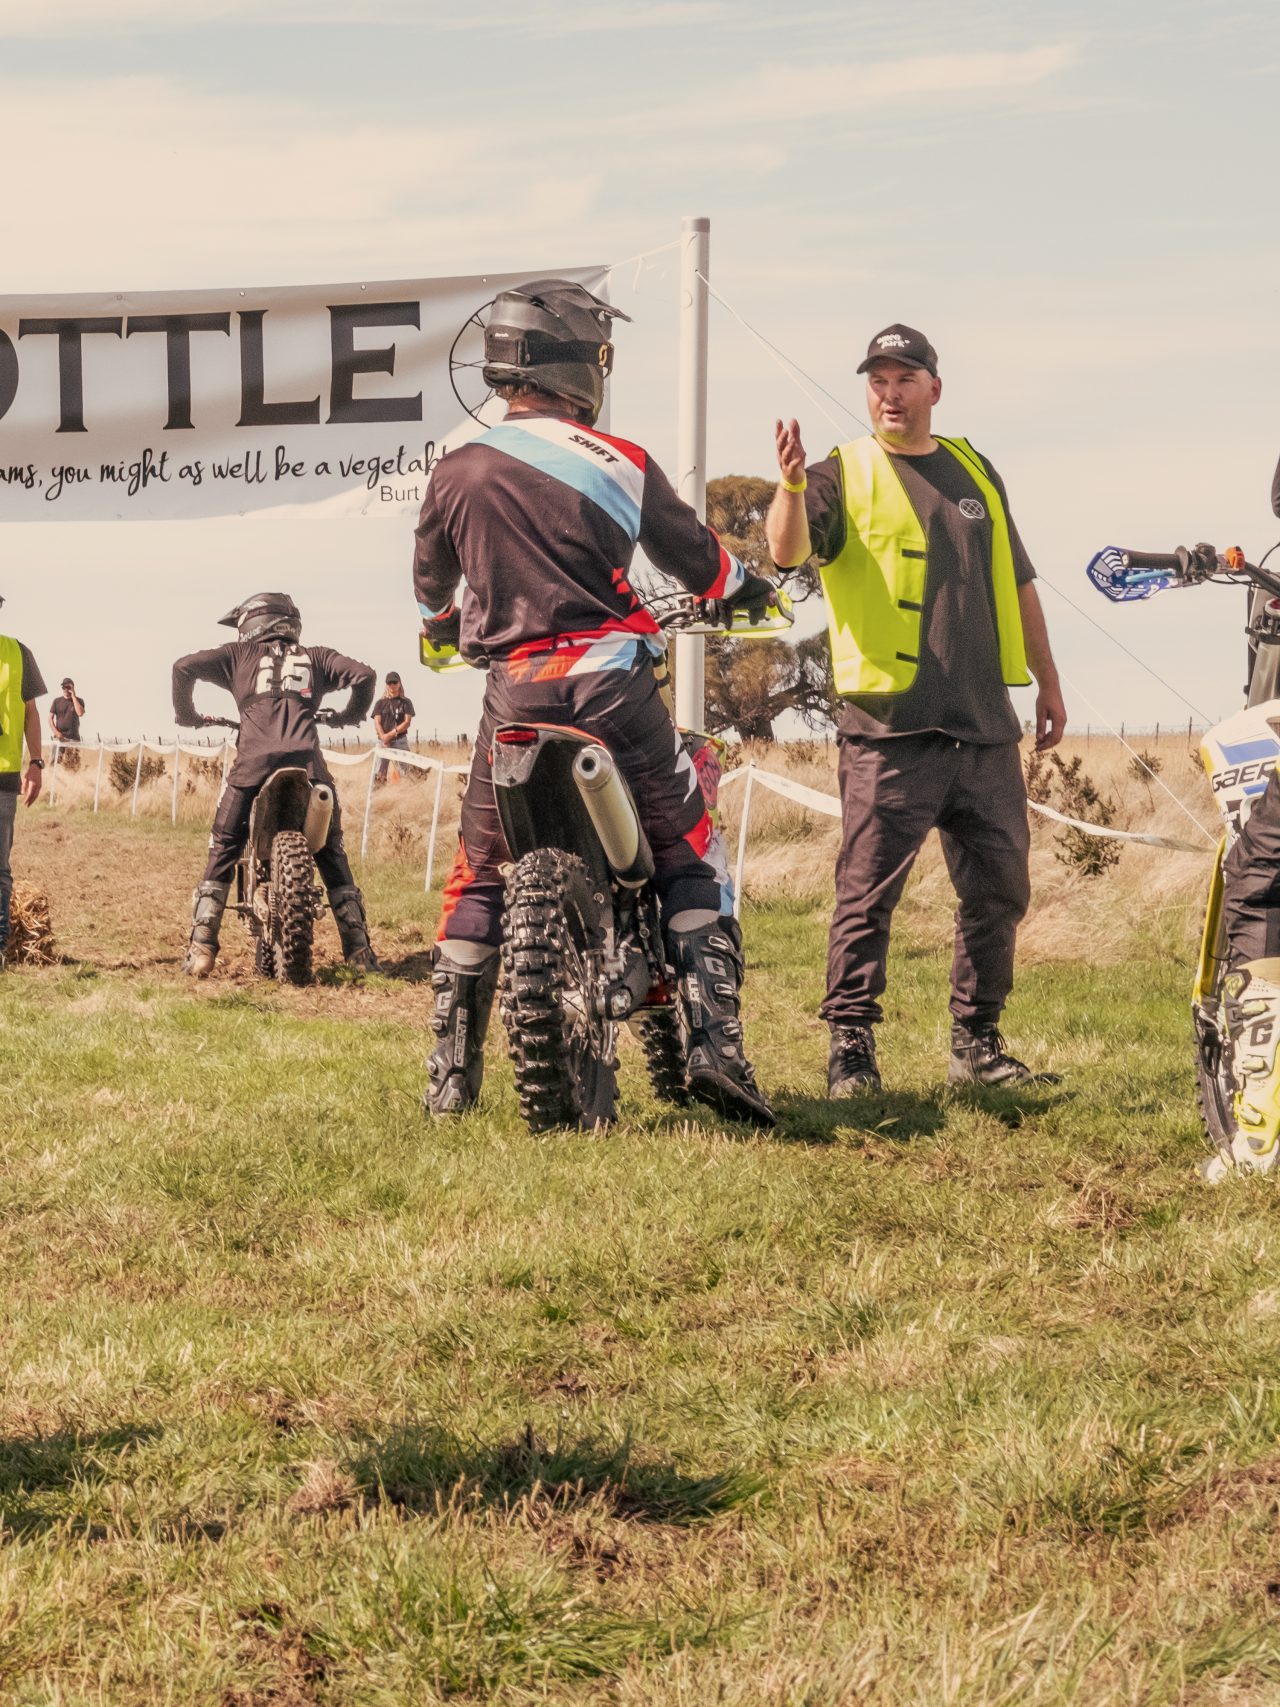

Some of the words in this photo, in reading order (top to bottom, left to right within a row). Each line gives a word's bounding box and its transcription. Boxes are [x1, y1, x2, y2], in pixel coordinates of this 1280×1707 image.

[567, 434, 620, 464] SHIFT
[44, 464, 93, 502] you
[100, 447, 172, 497] might
[178, 460, 205, 486] as
[212, 450, 268, 484] well
[274, 444, 308, 481] be
[314, 461, 333, 476] a
[380, 485, 421, 502] Burt
